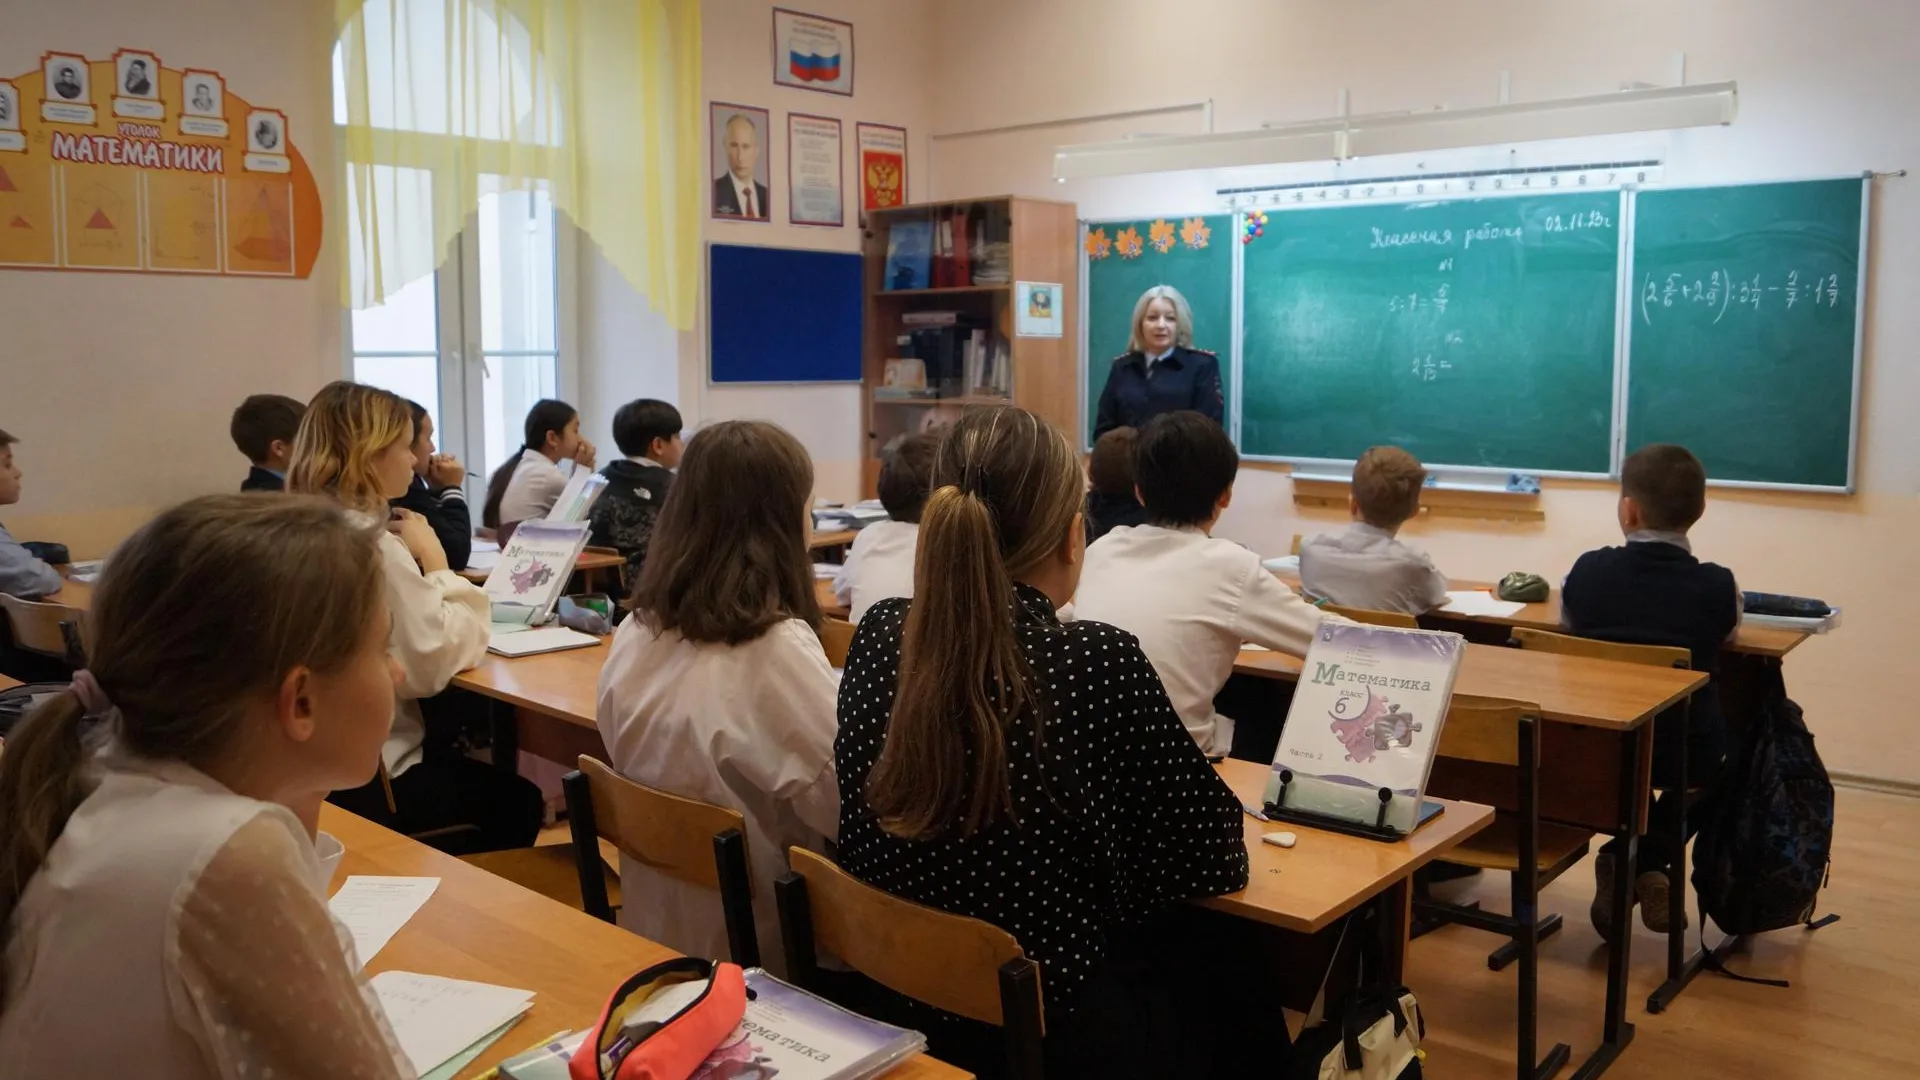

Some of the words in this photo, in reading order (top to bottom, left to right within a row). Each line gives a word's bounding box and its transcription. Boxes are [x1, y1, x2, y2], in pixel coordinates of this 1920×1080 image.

[117, 121, 161, 140] УГОЛОК
[52, 131, 224, 174] МАТЕМАТИКИ
[1416, 183, 1424, 194] 0
[1467, 181, 1476, 191] 2
[1521, 177, 1530, 187] 4
[1550, 176, 1559, 186] 5
[1578, 174, 1587, 184] 6
[1608, 173, 1616, 183] 7
[1637, 172, 1645, 182] 8
[1311, 661, 1432, 692] Математика
[1334, 697, 1350, 714] 6
